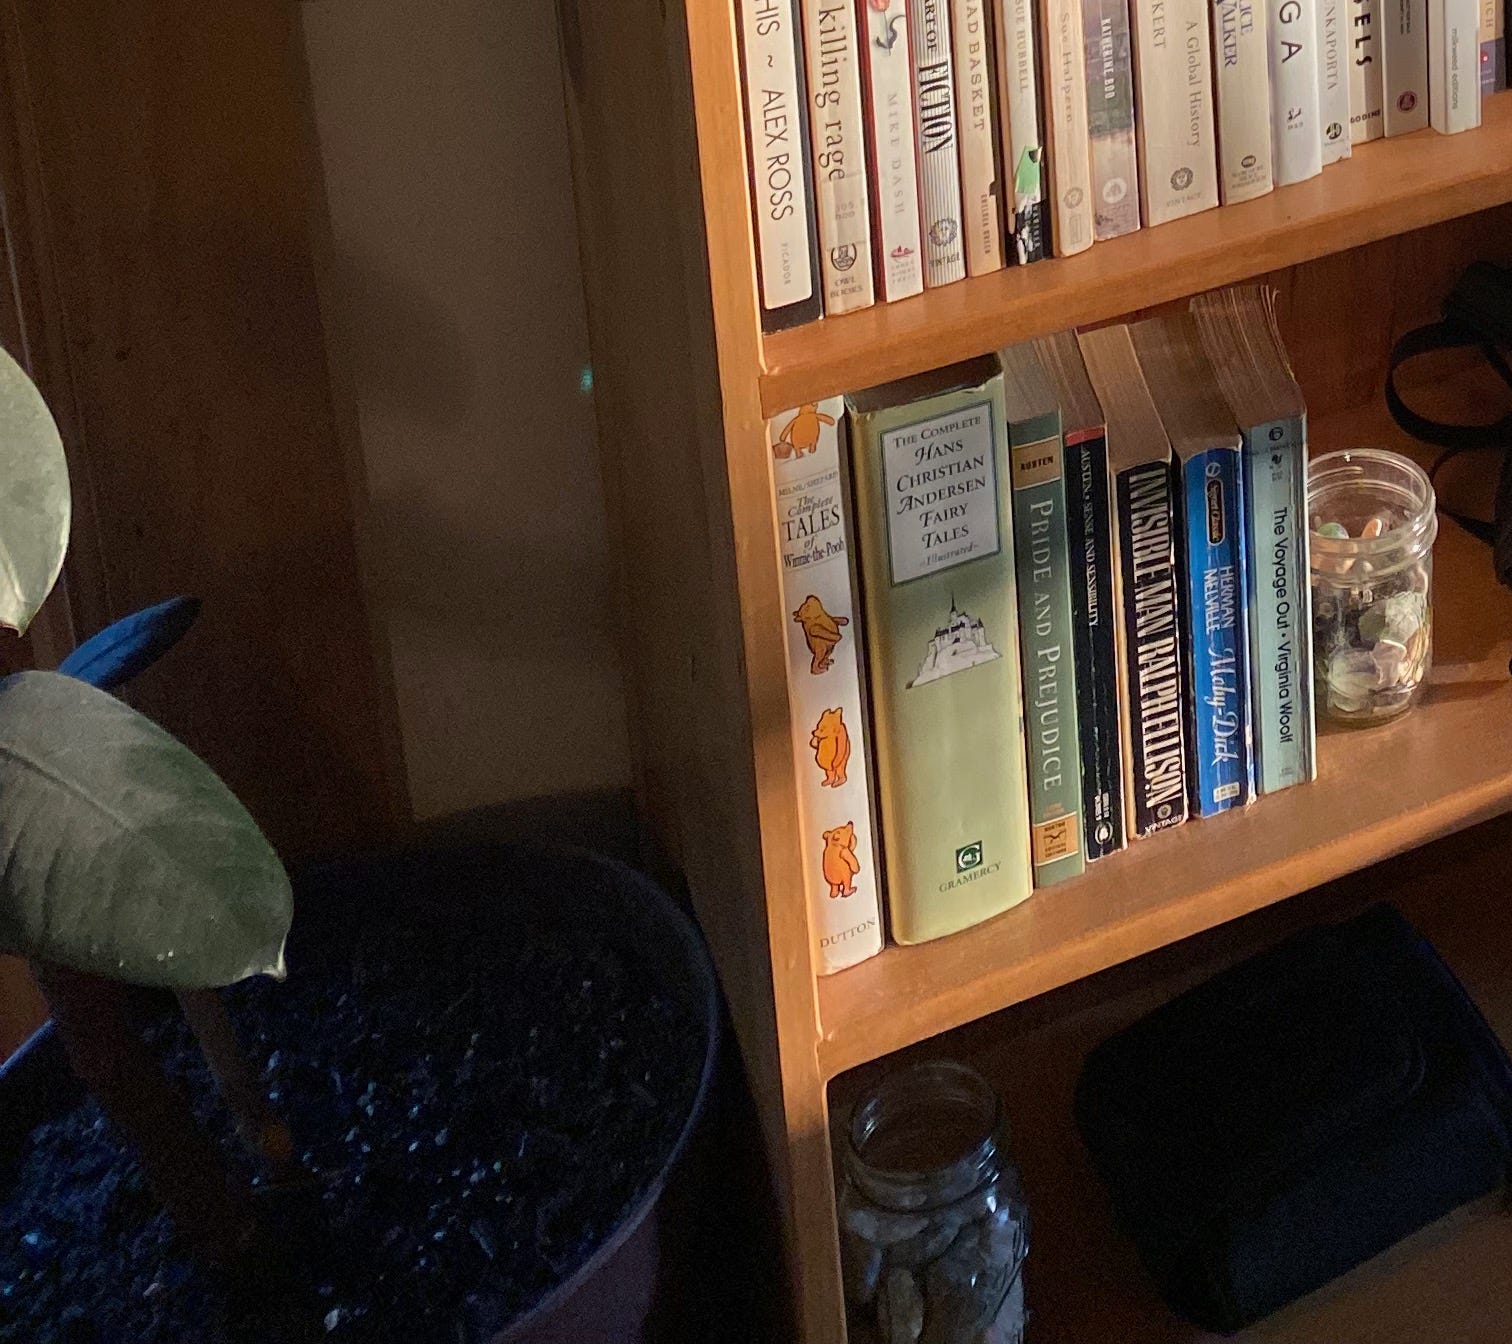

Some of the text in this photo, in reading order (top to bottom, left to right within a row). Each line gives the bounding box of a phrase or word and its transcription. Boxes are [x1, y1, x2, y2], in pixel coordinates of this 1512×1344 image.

[815, 4, 849, 182] killing rage
[916, 59, 953, 154] FICTION
[761, 89, 794, 221] ALEX ROSS
[1129, 471, 1174, 637] INVISIBLE MAN
[1204, 569, 1221, 635] MELVILLE
[1219, 566, 1235, 628] HERMAN
[1272, 507, 1290, 629] The Voyage Out
[1204, 648, 1239, 765] Moby-Dick
[1275, 641, 1294, 744] Virginia Woolf
[820, 919, 876, 947] DUTTON
